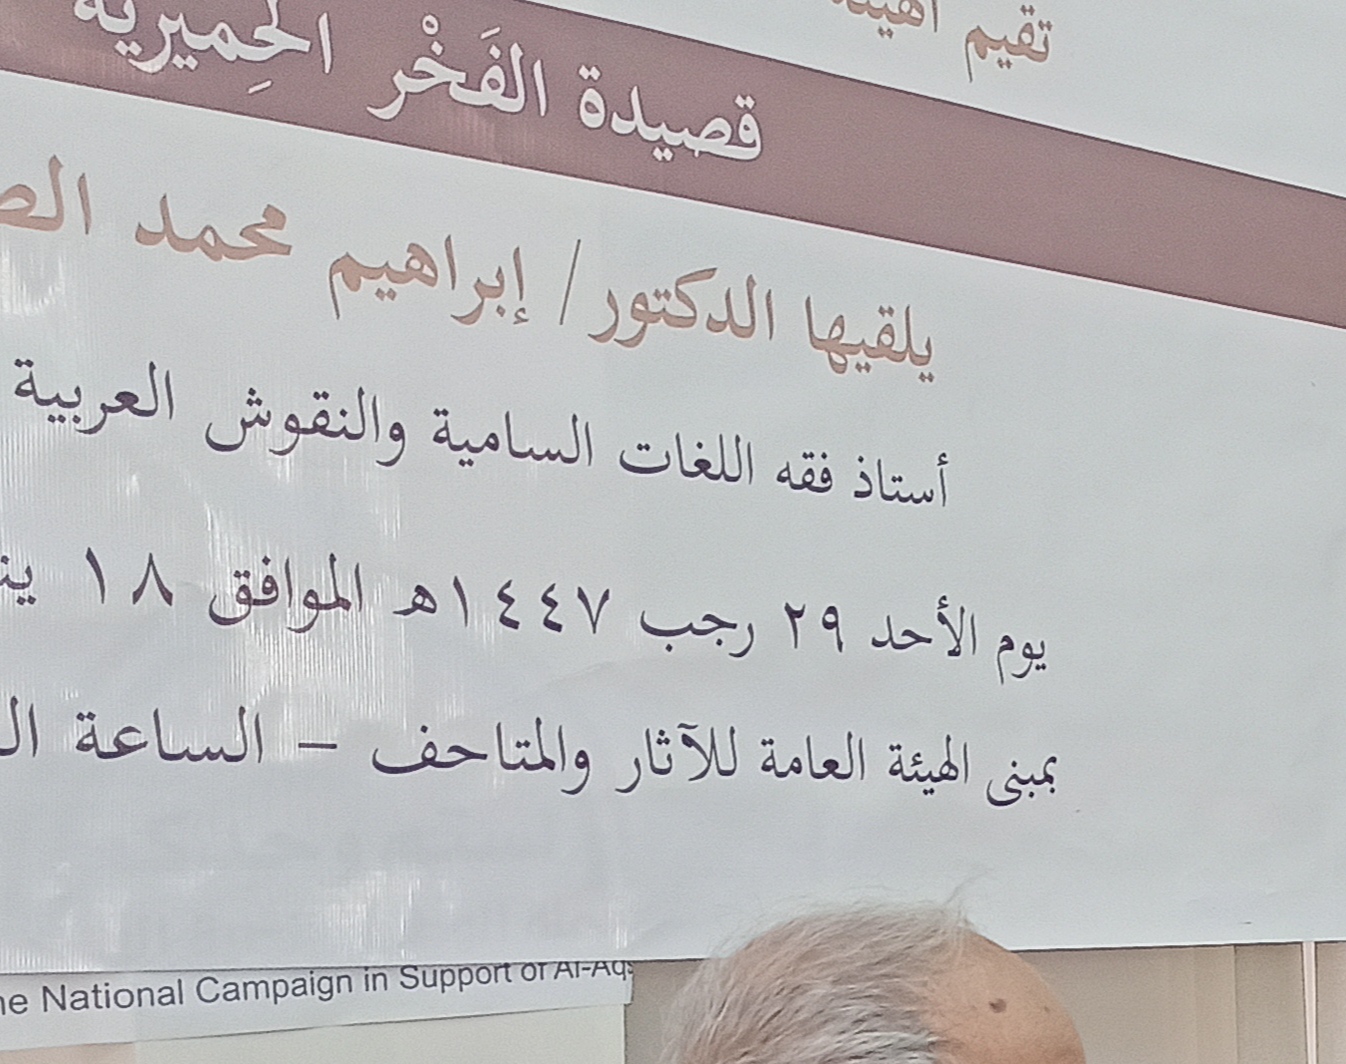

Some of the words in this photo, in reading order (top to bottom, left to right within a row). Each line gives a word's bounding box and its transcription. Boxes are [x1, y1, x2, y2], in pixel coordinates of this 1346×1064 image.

[965, 5, 1053, 83] تقيم
[578, 64, 763, 161] قصيدة
[135, 193, 293, 262] محمد
[328, 234, 529, 326] إبراهيم
[805, 295, 935, 383] يلقيها
[14, 361, 176, 433] العربية
[204, 385, 407, 466] والنقوش
[432, 407, 595, 466] السامية
[618, 432, 755, 486] اللغات
[775, 450, 834, 494] فقه
[853, 452, 949, 508] أستاذ
[85, 546, 174, 607] ١٨
[207, 552, 364, 634] الموافق
[639, 607, 757, 659] رجب
[783, 602, 844, 653] ٢٩
[870, 594, 978, 657] الأحد
[996, 633, 1048, 685] يوم
[75, 705, 265, 764] الساعة
[371, 716, 592, 796] والمتاحف
[615, 722, 740, 794] للآثار
[760, 730, 865, 781] العامة
[887, 734, 970, 796] الهيئة
[985, 753, 1059, 807] بمبنى
[42, 979, 184, 1013] National
[195, 970, 353, 1005] Campaign
[364, 966, 388, 992] in
[400, 963, 513, 993] Support
